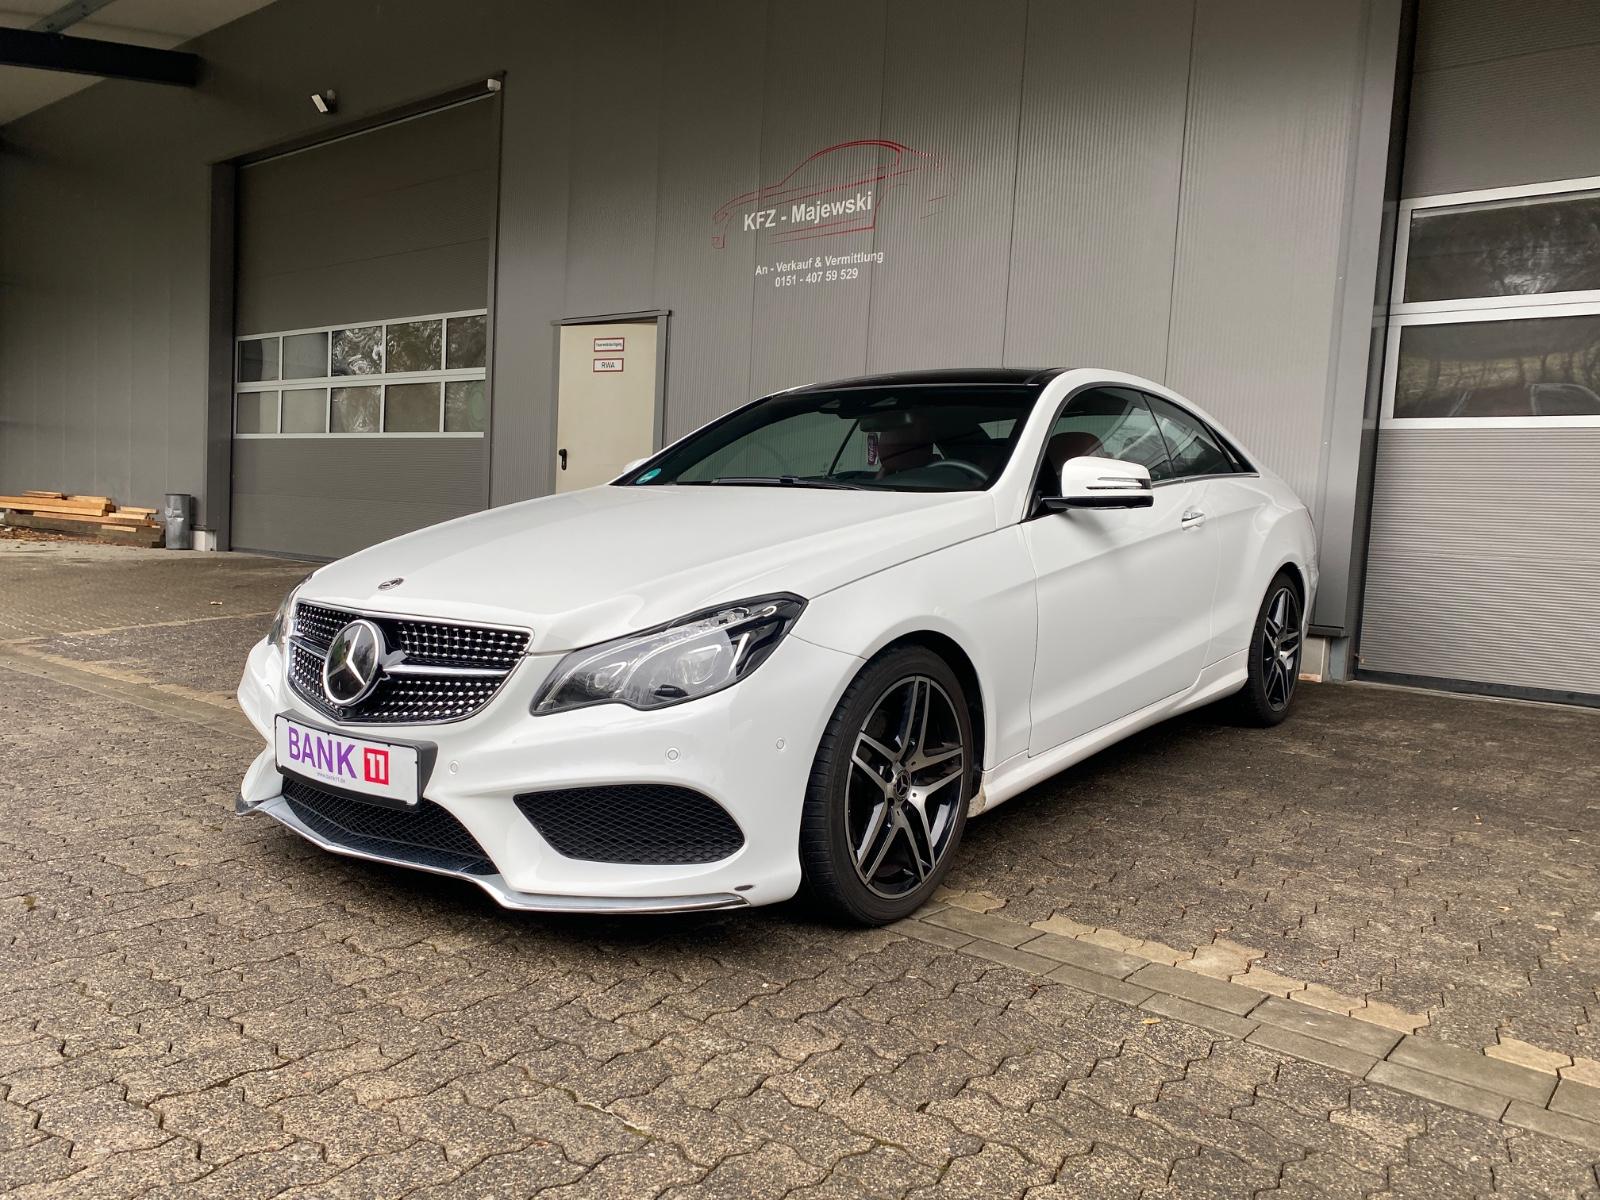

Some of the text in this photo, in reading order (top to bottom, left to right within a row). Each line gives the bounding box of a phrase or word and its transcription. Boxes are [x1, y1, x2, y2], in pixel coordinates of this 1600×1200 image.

[743, 208, 777, 232] KFZ
[791, 191, 872, 224] Majewski
[755, 265, 768, 276] An
[776, 259, 813, 273] Verkauf
[814, 256, 822, 268] &
[824, 251, 884, 267] Vermittlung
[775, 274, 797, 287] 0151
[805, 271, 823, 283] 407
[825, 269, 838, 281] 59
[840, 267, 859, 280] 529
[288, 726, 386, 781] BANK 11
